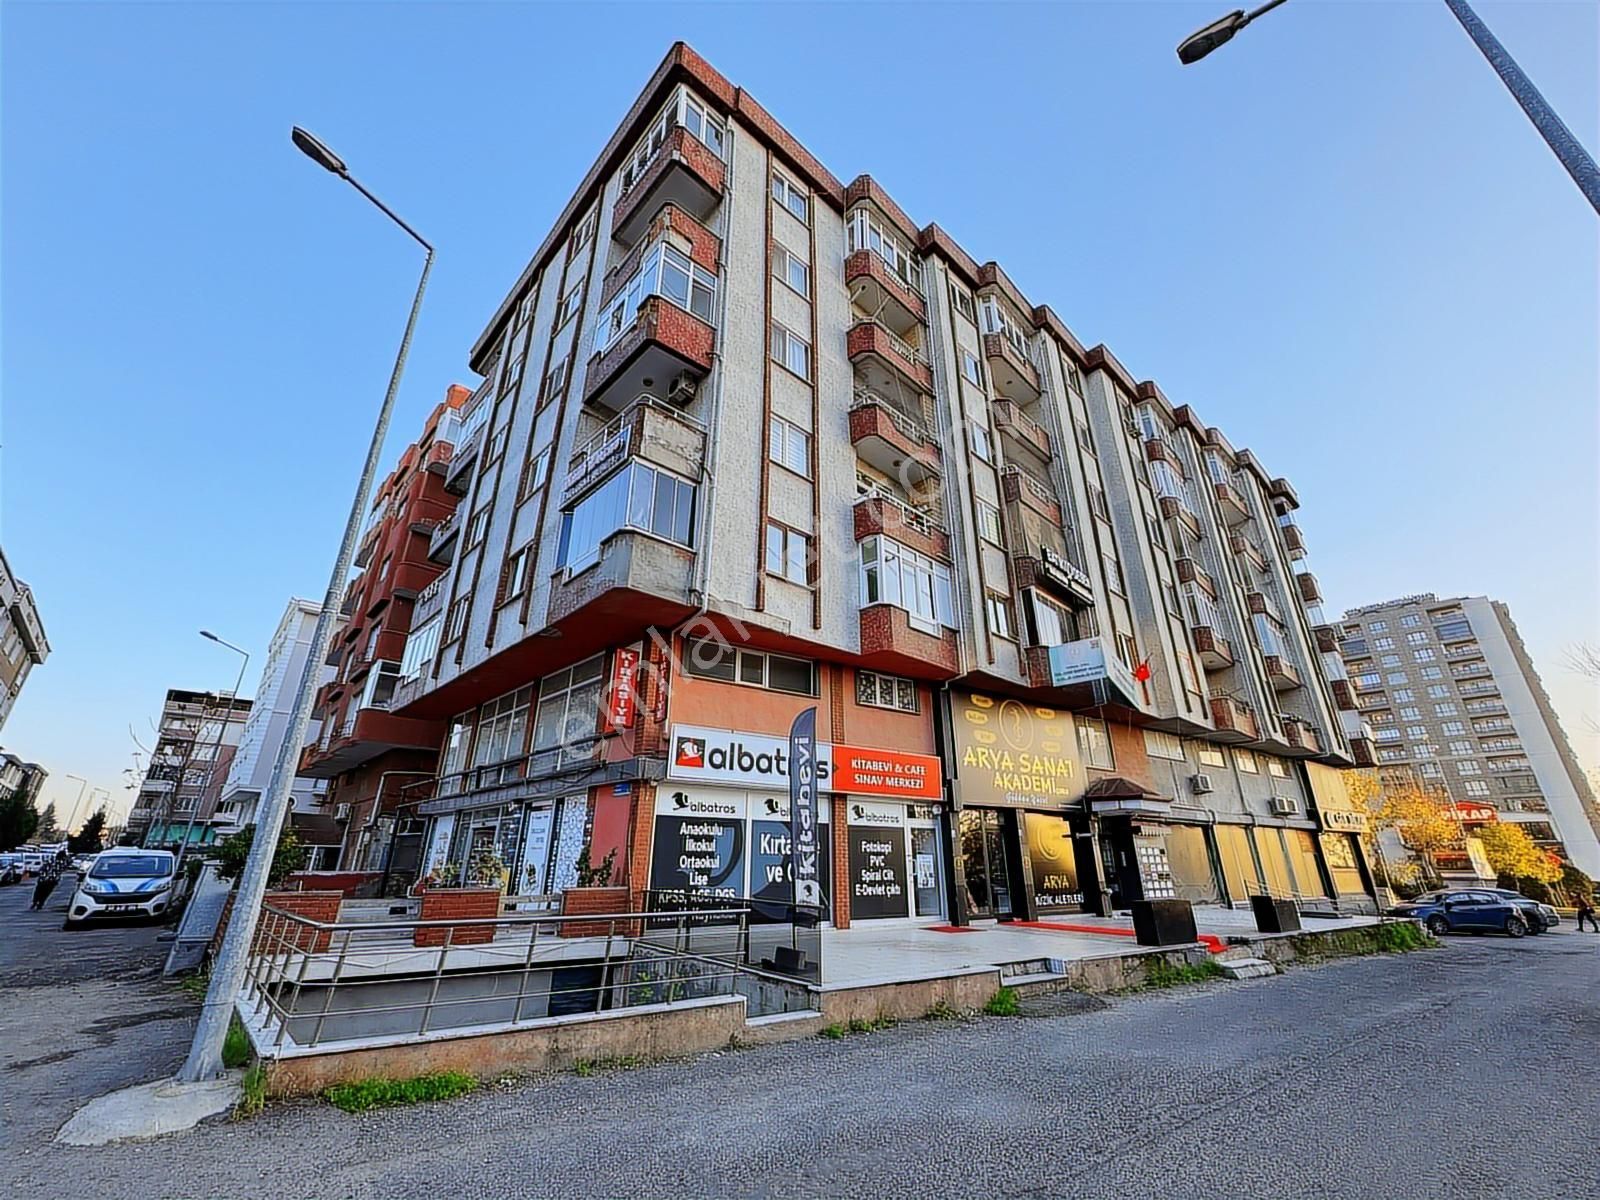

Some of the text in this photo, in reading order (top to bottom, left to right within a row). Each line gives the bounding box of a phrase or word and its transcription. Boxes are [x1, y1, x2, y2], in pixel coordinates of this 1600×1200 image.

[708, 742, 828, 779] albats
[851, 757, 926, 776] KİTABEVİ & CAFE
[964, 745, 1074, 778] ARYA SANAT
[854, 773, 924, 789] SINAV MERKEZİ
[690, 802, 736, 814] albatros
[865, 810, 900, 823] albatros
[680, 822, 723, 836] Anaokulu
[685, 835, 716, 852] İlkokul
[679, 854, 720, 869] Ortaokul
[869, 855, 885, 867] PVC
[689, 871, 708, 886] Lise
[765, 865, 783, 882] ve
[861, 869, 881, 883] Spiral
[1043, 874, 1070, 889] ARYA
[855, 884, 886, 896] E-Devlet
